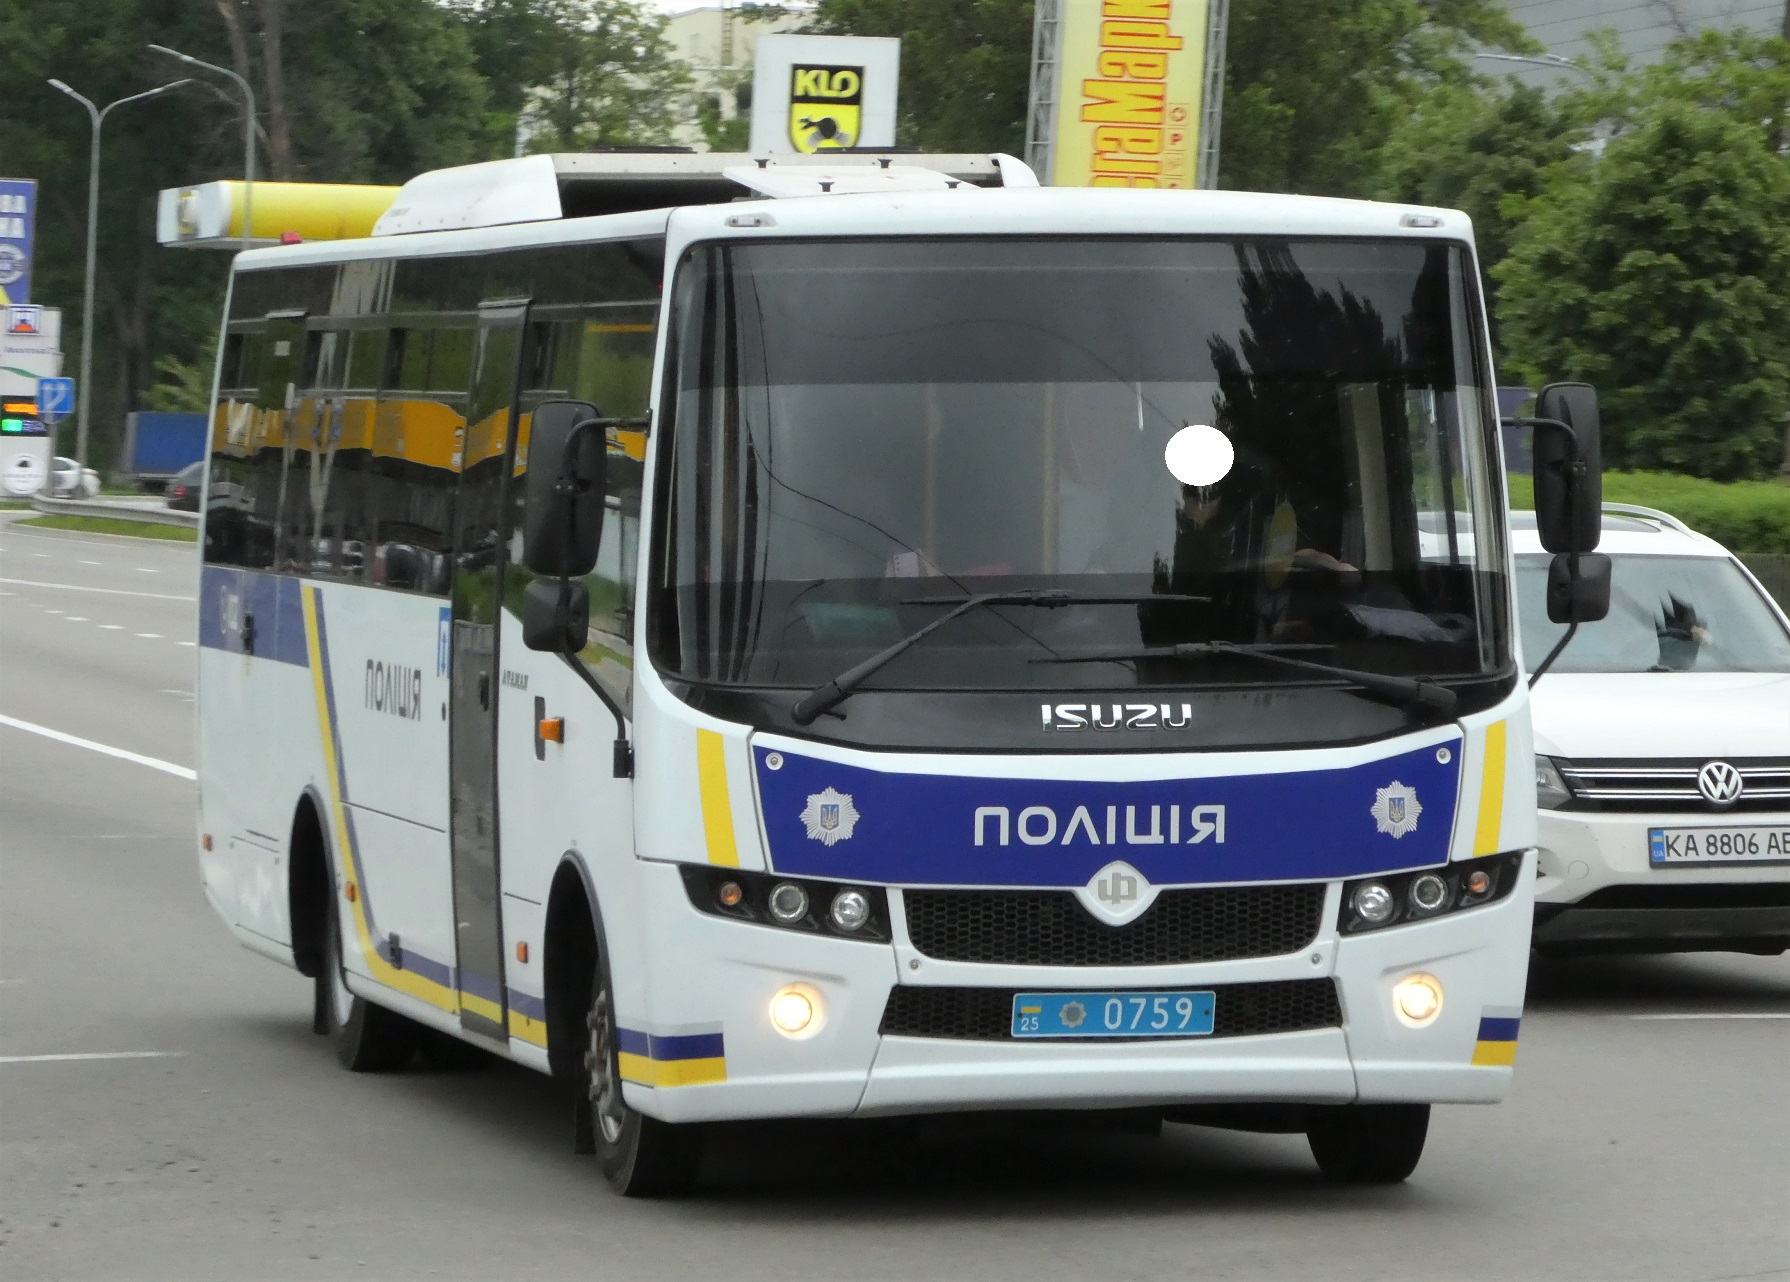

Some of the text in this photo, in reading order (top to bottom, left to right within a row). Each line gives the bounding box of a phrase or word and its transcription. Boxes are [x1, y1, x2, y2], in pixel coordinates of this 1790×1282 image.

[793, 69, 860, 98] KLO
[365, 658, 421, 722] ПОЛІЦІЯ
[1041, 703, 1192, 732] ISUZU
[1699, 762, 1743, 804] VW
[974, 805, 1225, 846] ПОЛІЦІЯ
[1665, 834, 1699, 857] KA
[1705, 832, 1759, 856] 8806
[1021, 1017, 1039, 1031] 25
[1104, 998, 1193, 1030] 0759
